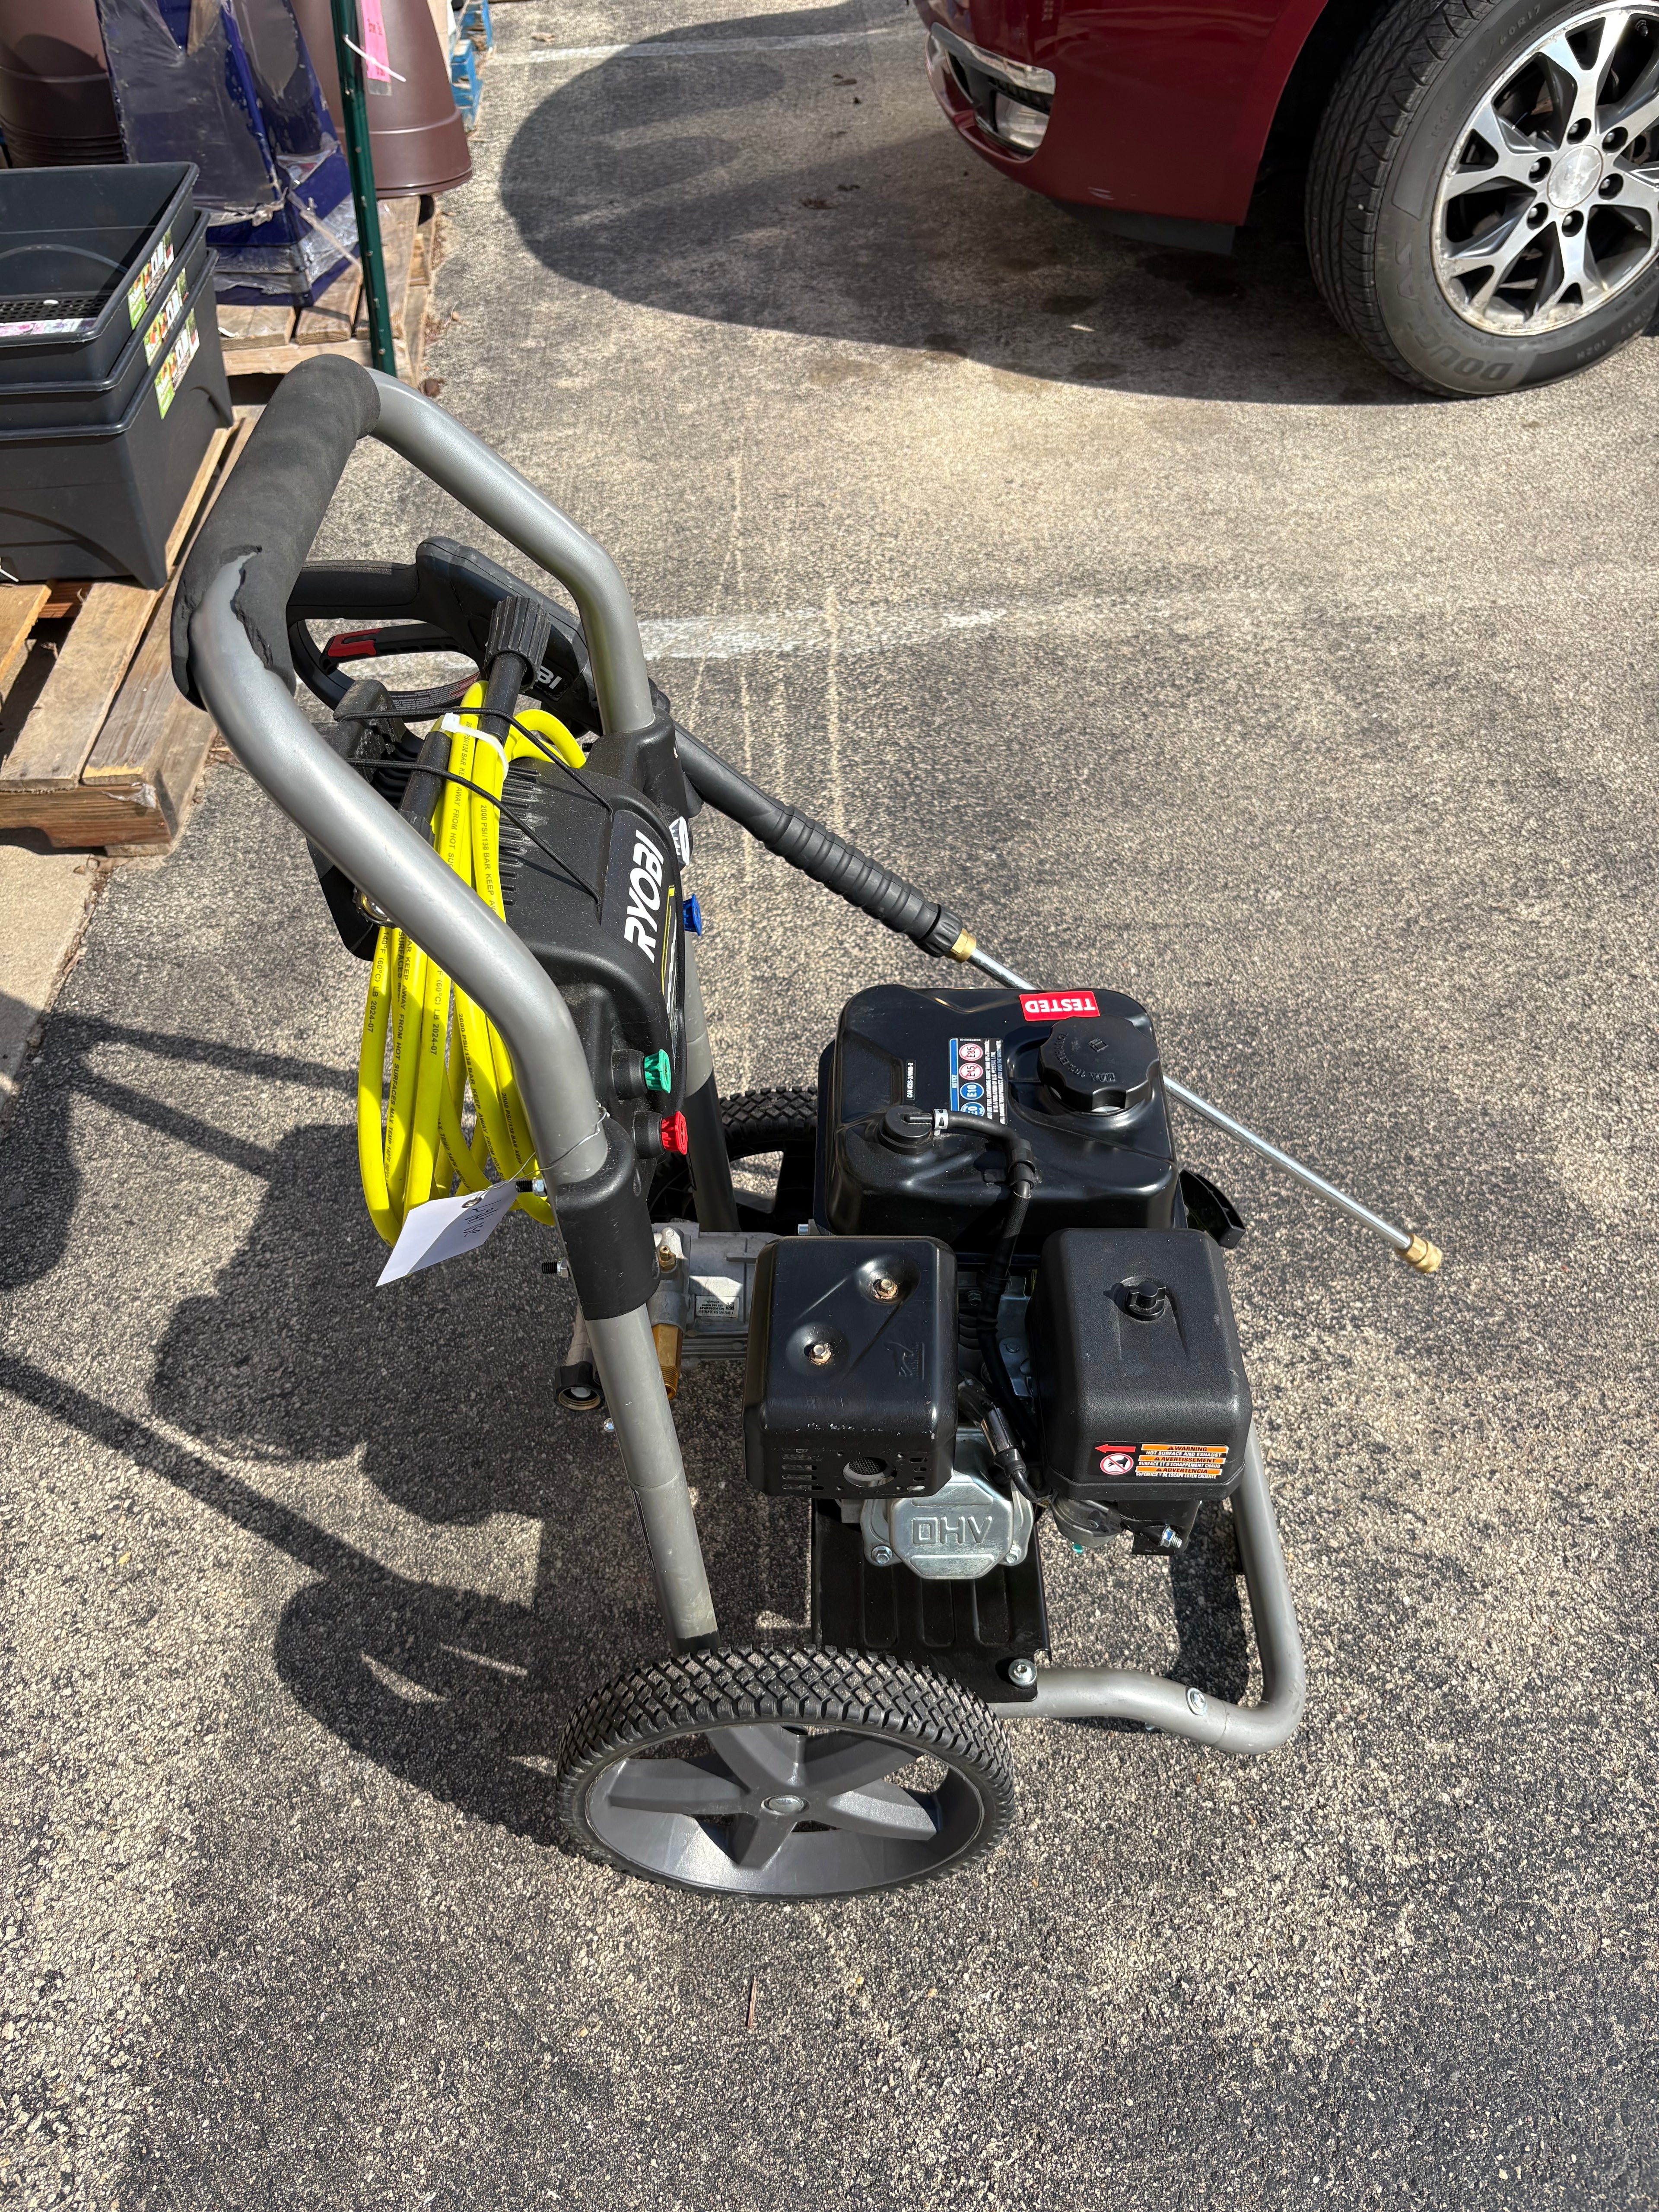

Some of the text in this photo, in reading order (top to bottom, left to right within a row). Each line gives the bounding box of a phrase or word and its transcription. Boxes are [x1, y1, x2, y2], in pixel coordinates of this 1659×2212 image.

[454, 787, 462, 807] AWAY
[451, 809, 460, 830] FROM
[485, 874, 494, 896] KEEP
[624, 830, 664, 964] RYOBI
[372, 986, 379, 998] LB
[400, 985, 408, 1010] AWAY
[368, 1001, 377, 1033] 2024-07
[433, 1009, 440, 1020] LB
[1024, 998, 1096, 1013] TESTED
[430, 1023, 439, 1055] 2024-07
[391, 1063, 400, 1106] SURFACES
[967, 1084, 977, 1097] E10
[472, 1088, 481, 1109] KEEP
[478, 1112, 488, 1134] AWAY
[485, 1136, 495, 1157] FROM
[912, 1516, 992, 1545] OHV
